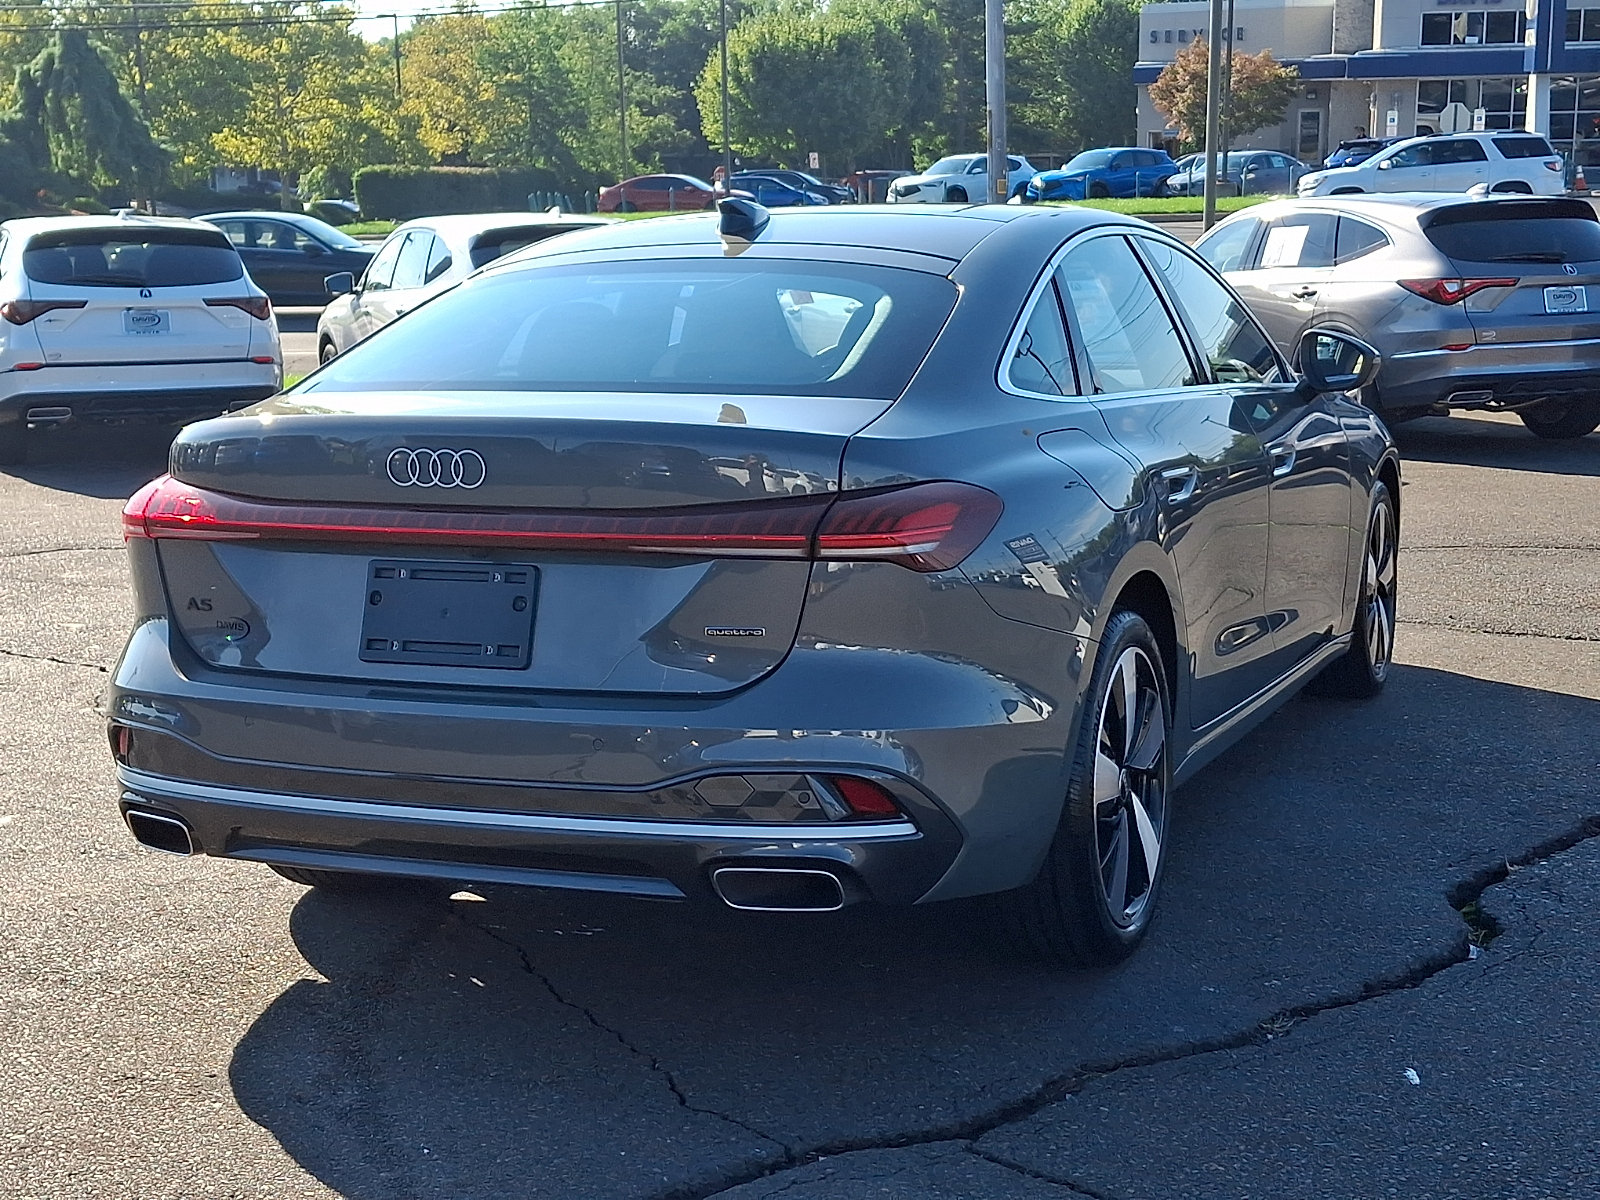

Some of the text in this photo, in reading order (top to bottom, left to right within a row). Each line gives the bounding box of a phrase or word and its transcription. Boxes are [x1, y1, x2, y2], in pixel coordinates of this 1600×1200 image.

[1150, 27, 1244, 44] SERVCE
[187, 597, 213, 611] A5
[216, 620, 245, 631] DAVIS
[707, 628, 763, 636] quattro
